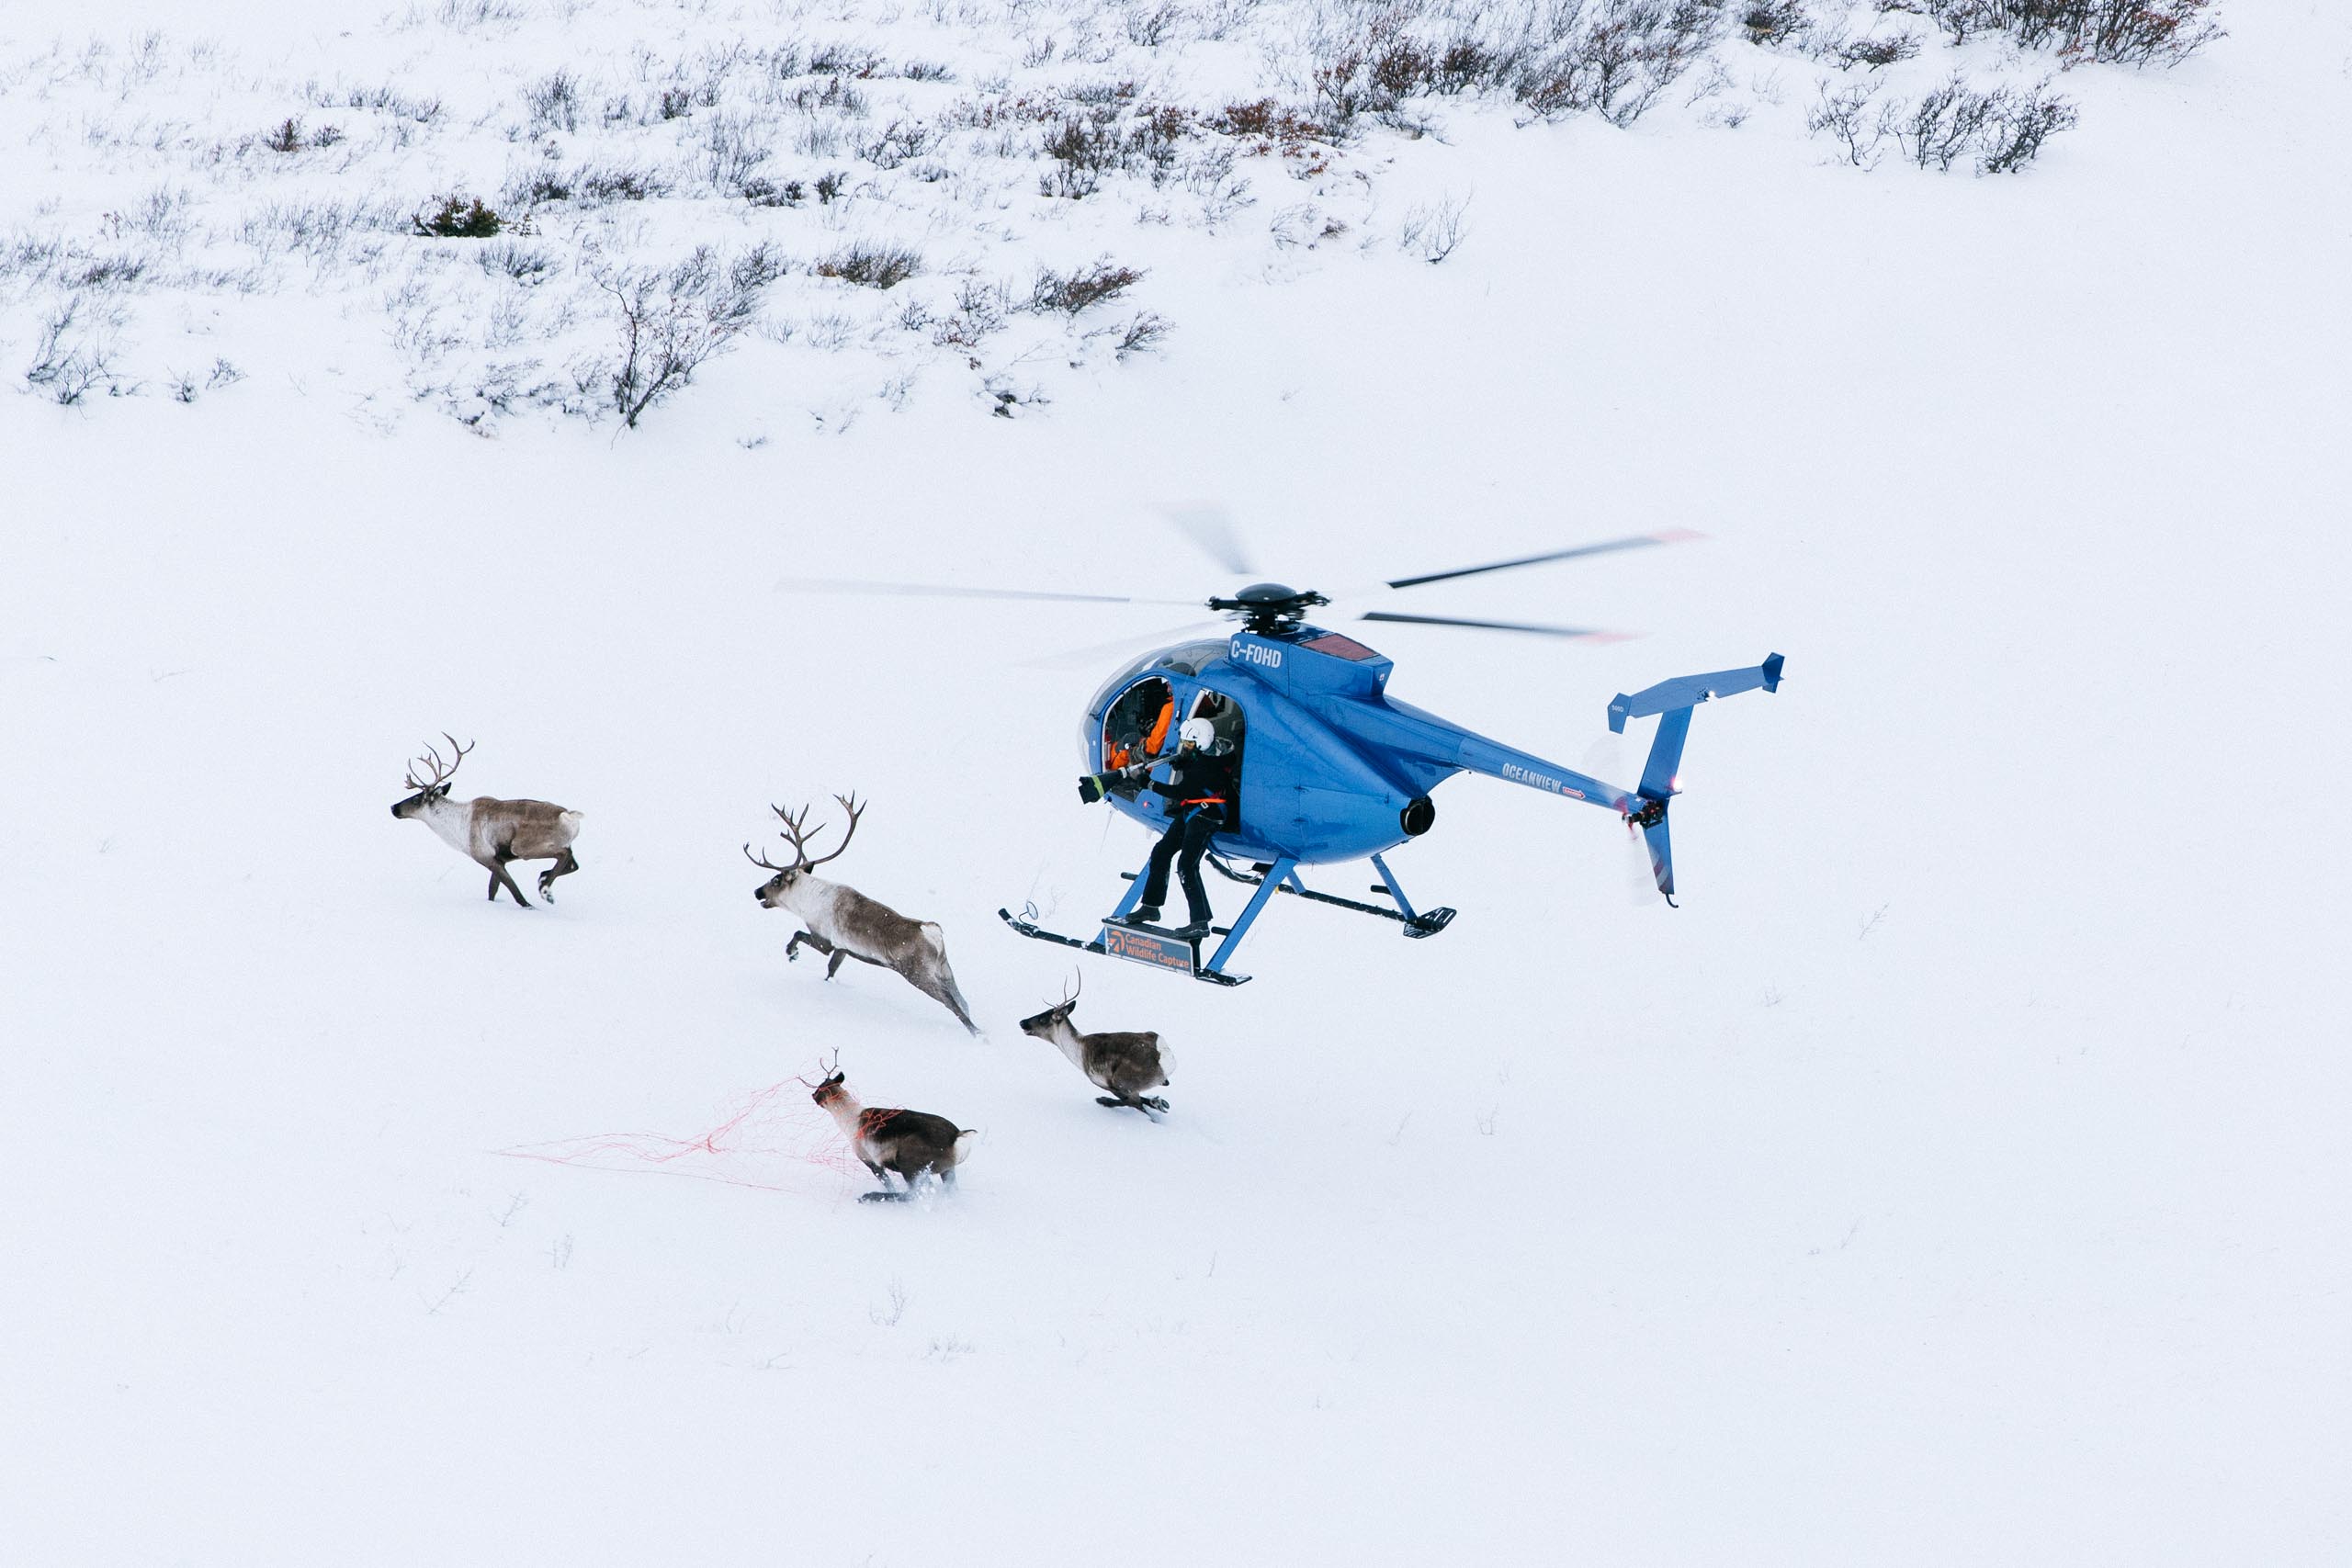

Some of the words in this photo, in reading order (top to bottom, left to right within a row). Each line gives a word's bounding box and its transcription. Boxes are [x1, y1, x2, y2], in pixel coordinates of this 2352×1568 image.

[1231, 640, 1282, 669] C-FOHD
[1502, 762, 1562, 793] OCEANVIEW
[1125, 933, 1161, 951] Canadian
[1126, 945, 1157, 961] Wildlife
[1159, 953, 1190, 968] Capture
